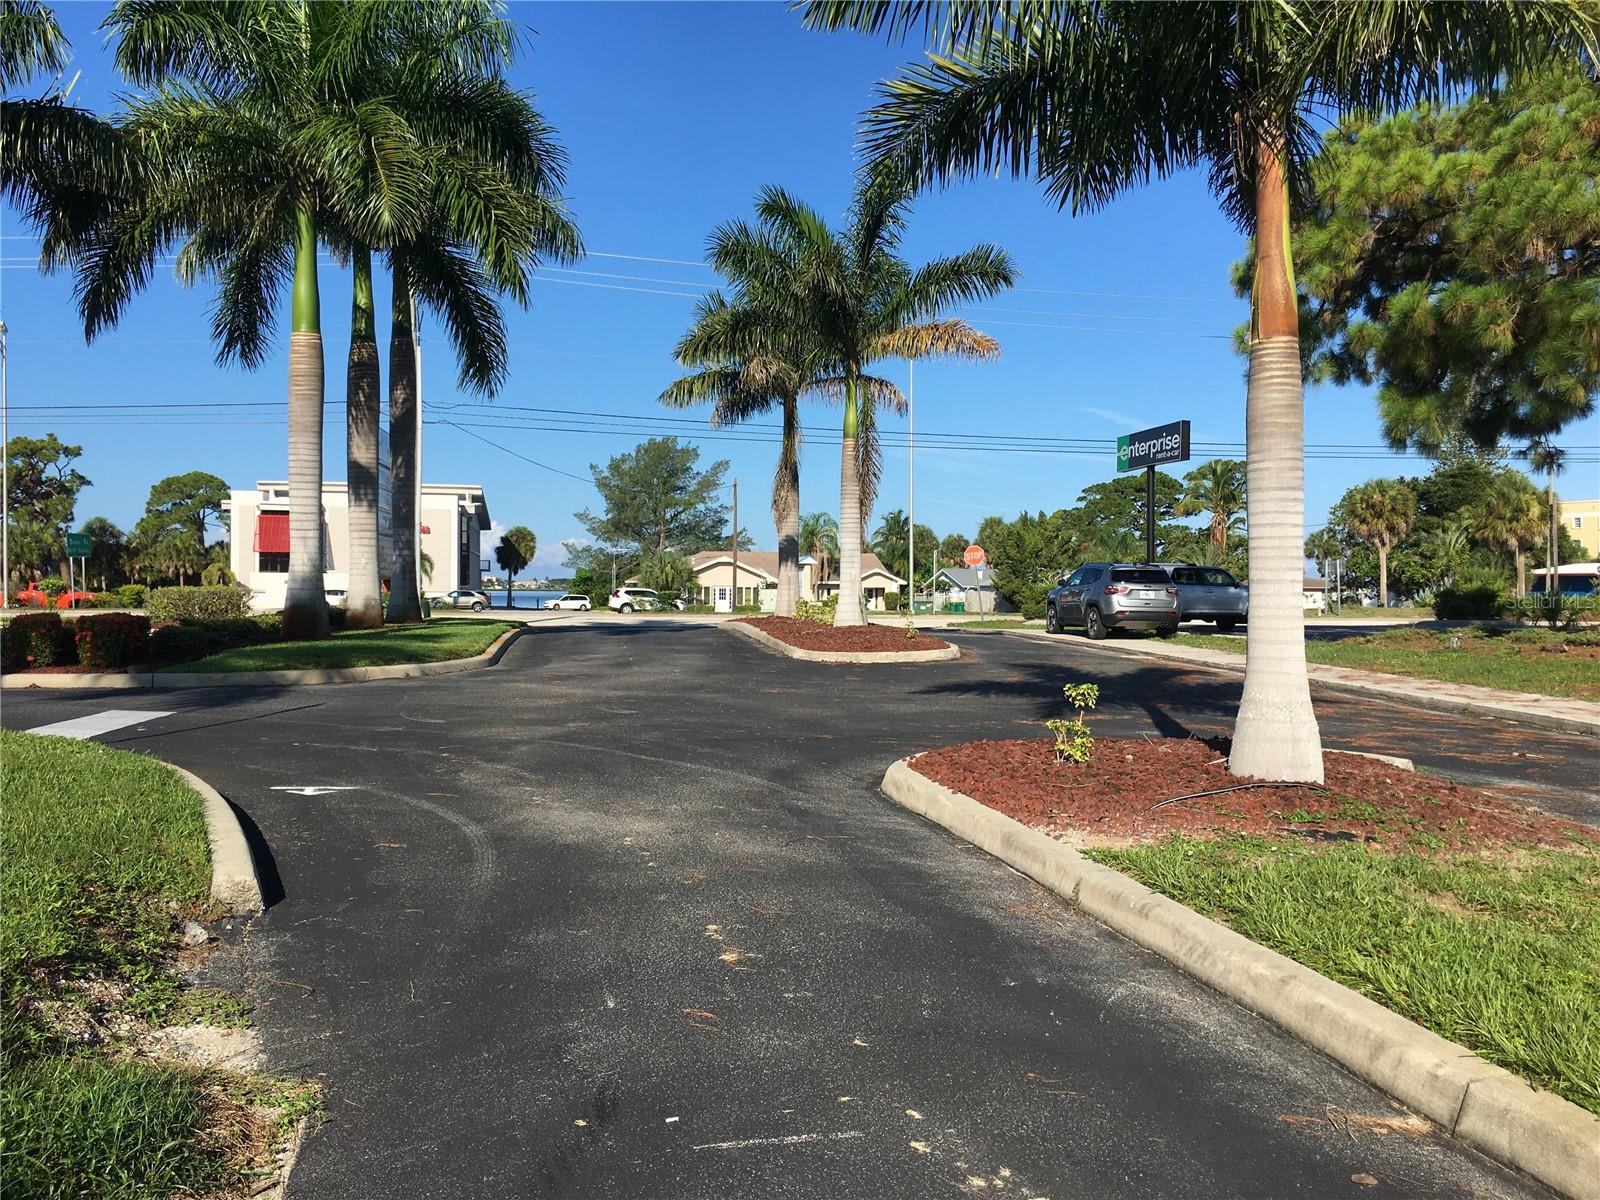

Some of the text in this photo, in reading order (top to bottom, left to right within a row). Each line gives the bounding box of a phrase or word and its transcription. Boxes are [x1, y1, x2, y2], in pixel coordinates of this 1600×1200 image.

[1117, 432, 1180, 460] enterprise
[1155, 449, 1180, 460] rent-a-car
[965, 552, 984, 561] STOP
